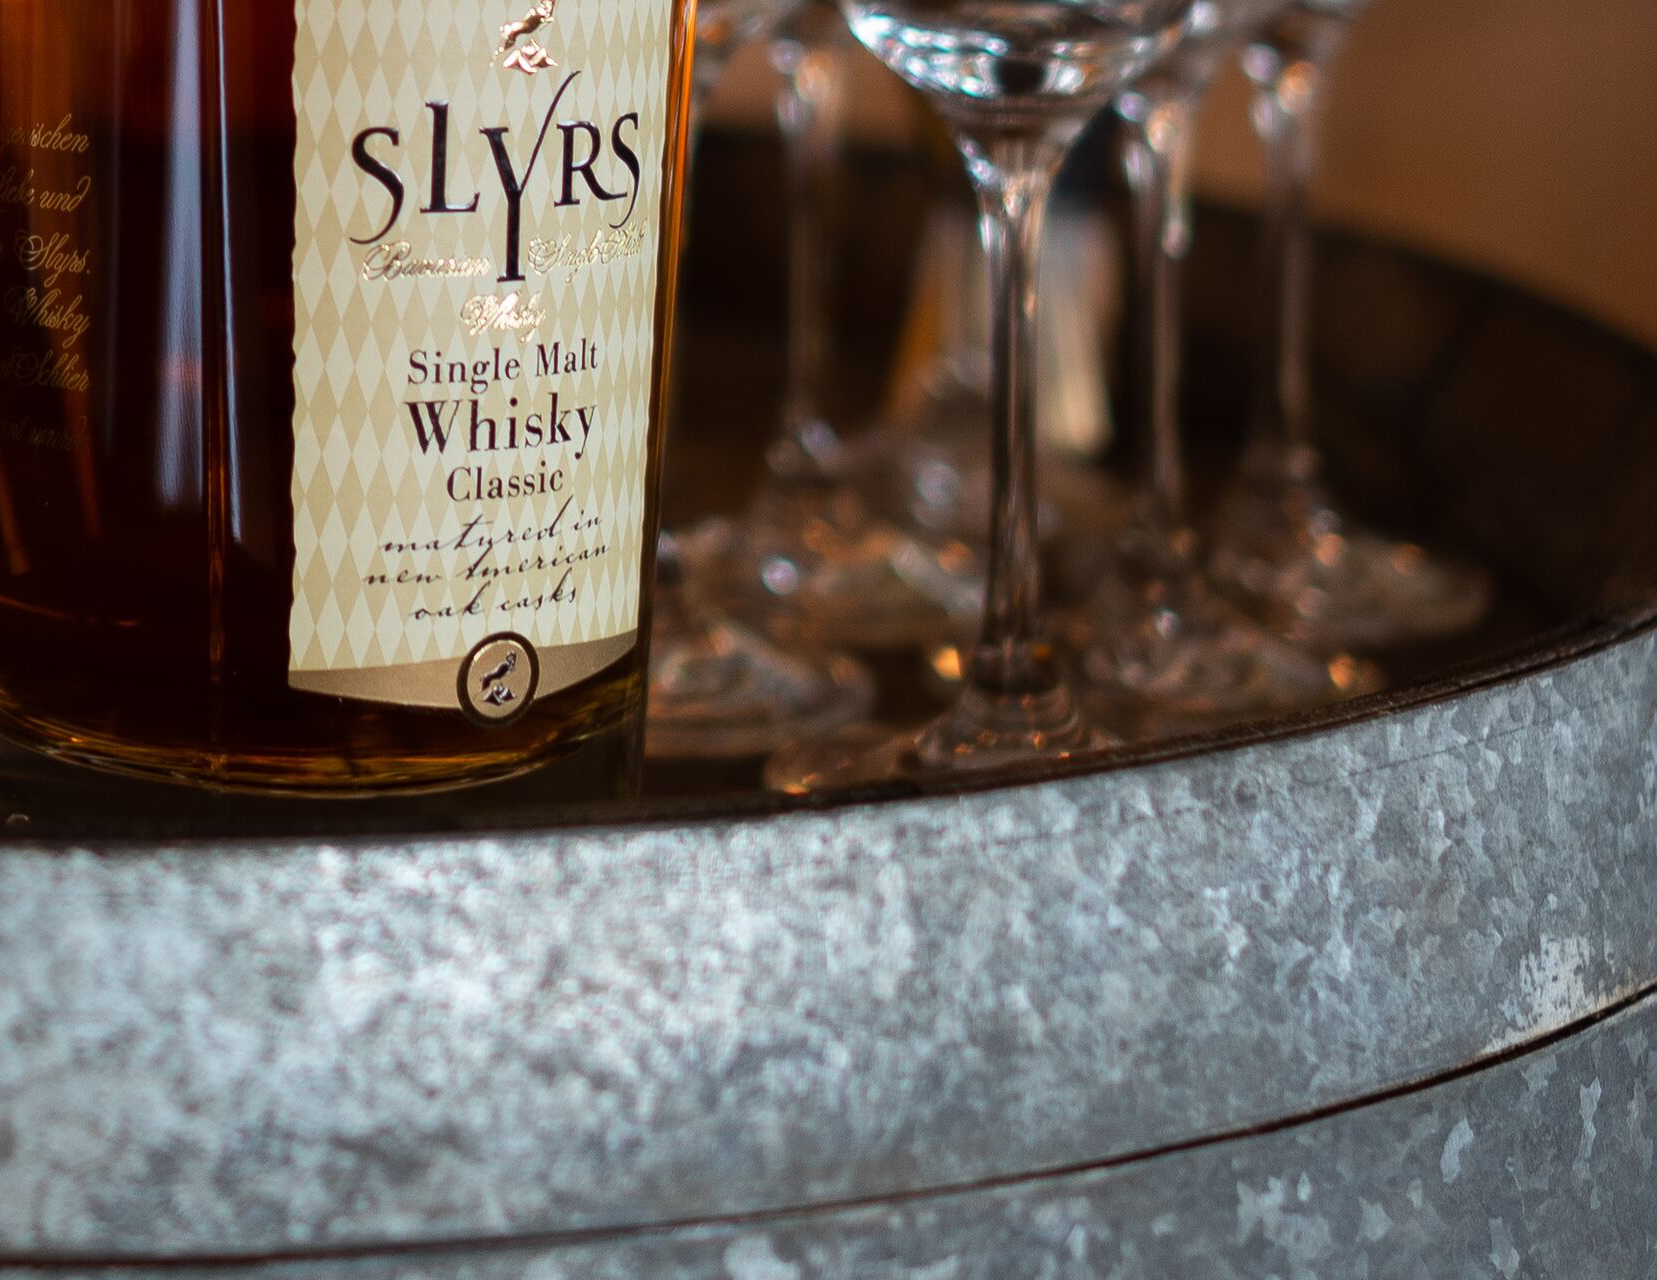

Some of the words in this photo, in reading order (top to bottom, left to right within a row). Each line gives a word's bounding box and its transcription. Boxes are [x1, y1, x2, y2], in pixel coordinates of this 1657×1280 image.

[349, 71, 640, 283] SLYRS
[407, 349, 521, 395] Single
[534, 338, 599, 378] Malt
[404, 391, 598, 461] Whisky
[446, 460, 565, 503] Classic
[378, 493, 575, 552] matured
[573, 510, 603, 533] in
[362, 569, 442, 586] new
[408, 580, 492, 622] oak
[498, 566, 578, 612] casks
